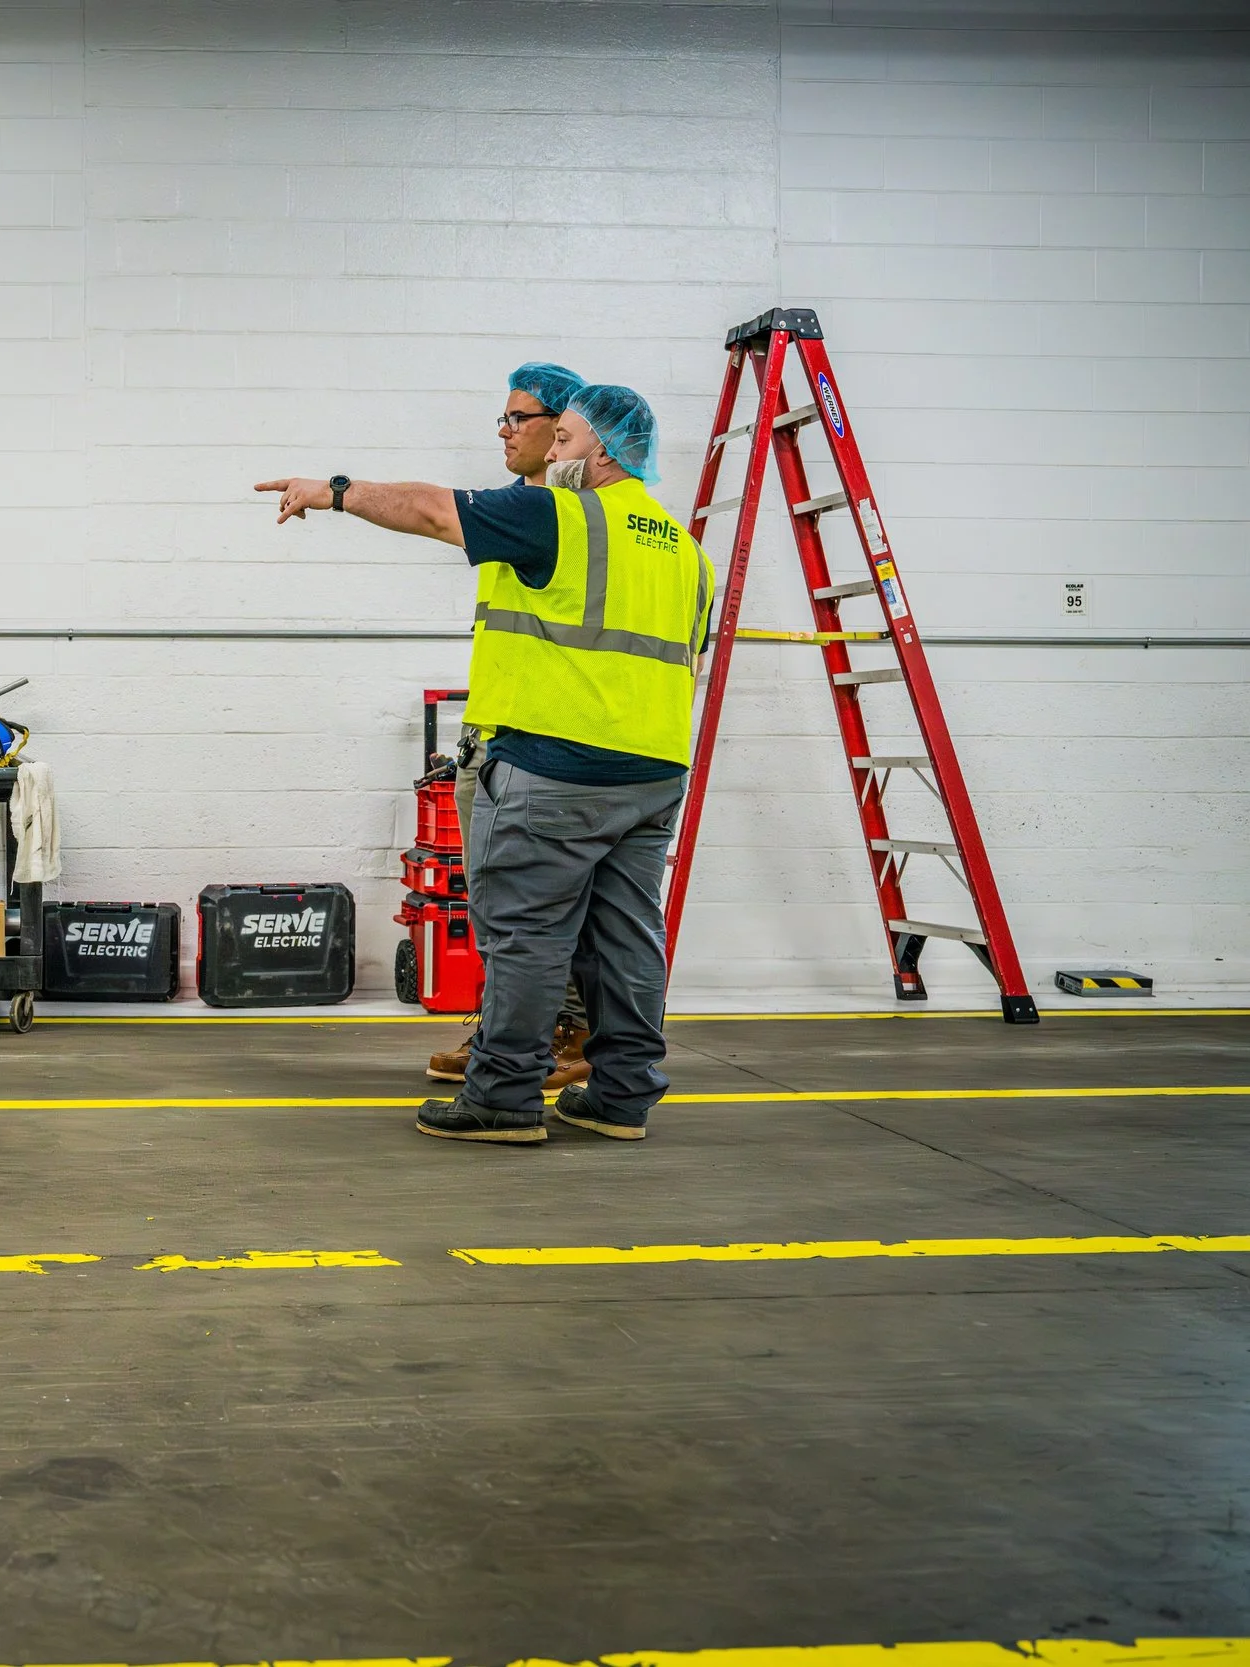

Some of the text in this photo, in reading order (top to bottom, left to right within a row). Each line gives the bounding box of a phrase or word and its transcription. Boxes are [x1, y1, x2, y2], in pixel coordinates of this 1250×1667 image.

[823, 386, 840, 424] WERNER
[627, 513, 679, 543] SERVE
[635, 534, 678, 554] ELECTRIC
[1066, 595, 1082, 607] 95
[65, 917, 154, 944] SERVE
[240, 906, 327, 935] SERVE
[78, 944, 148, 958] ELECTRIC
[254, 935, 322, 949] ELECTRIC
